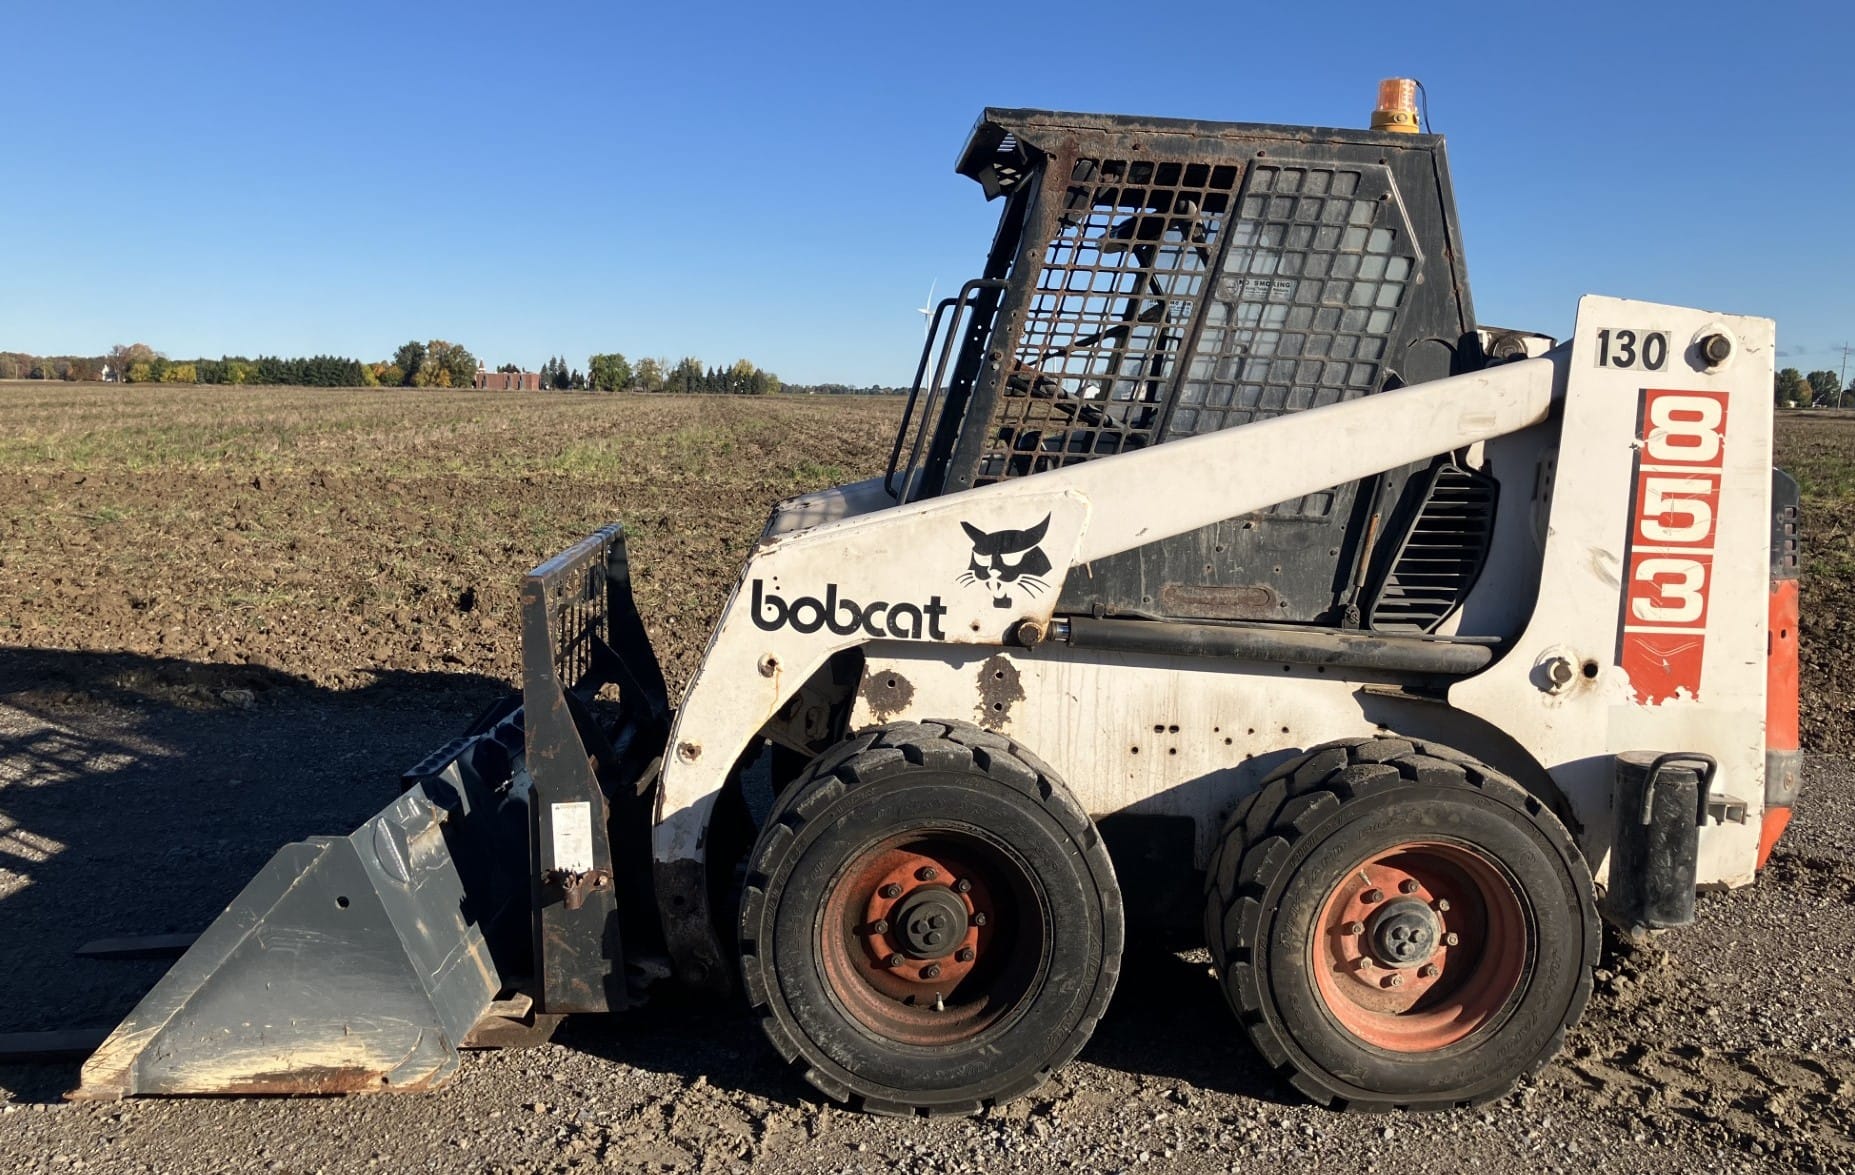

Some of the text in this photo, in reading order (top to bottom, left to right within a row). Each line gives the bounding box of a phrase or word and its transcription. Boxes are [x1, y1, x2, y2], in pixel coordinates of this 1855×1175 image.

[1254, 280, 1291, 288] SMOKING
[1598, 329, 1667, 371] 130
[1631, 395, 1722, 623] 853
[751, 579, 947, 640] bobcat
